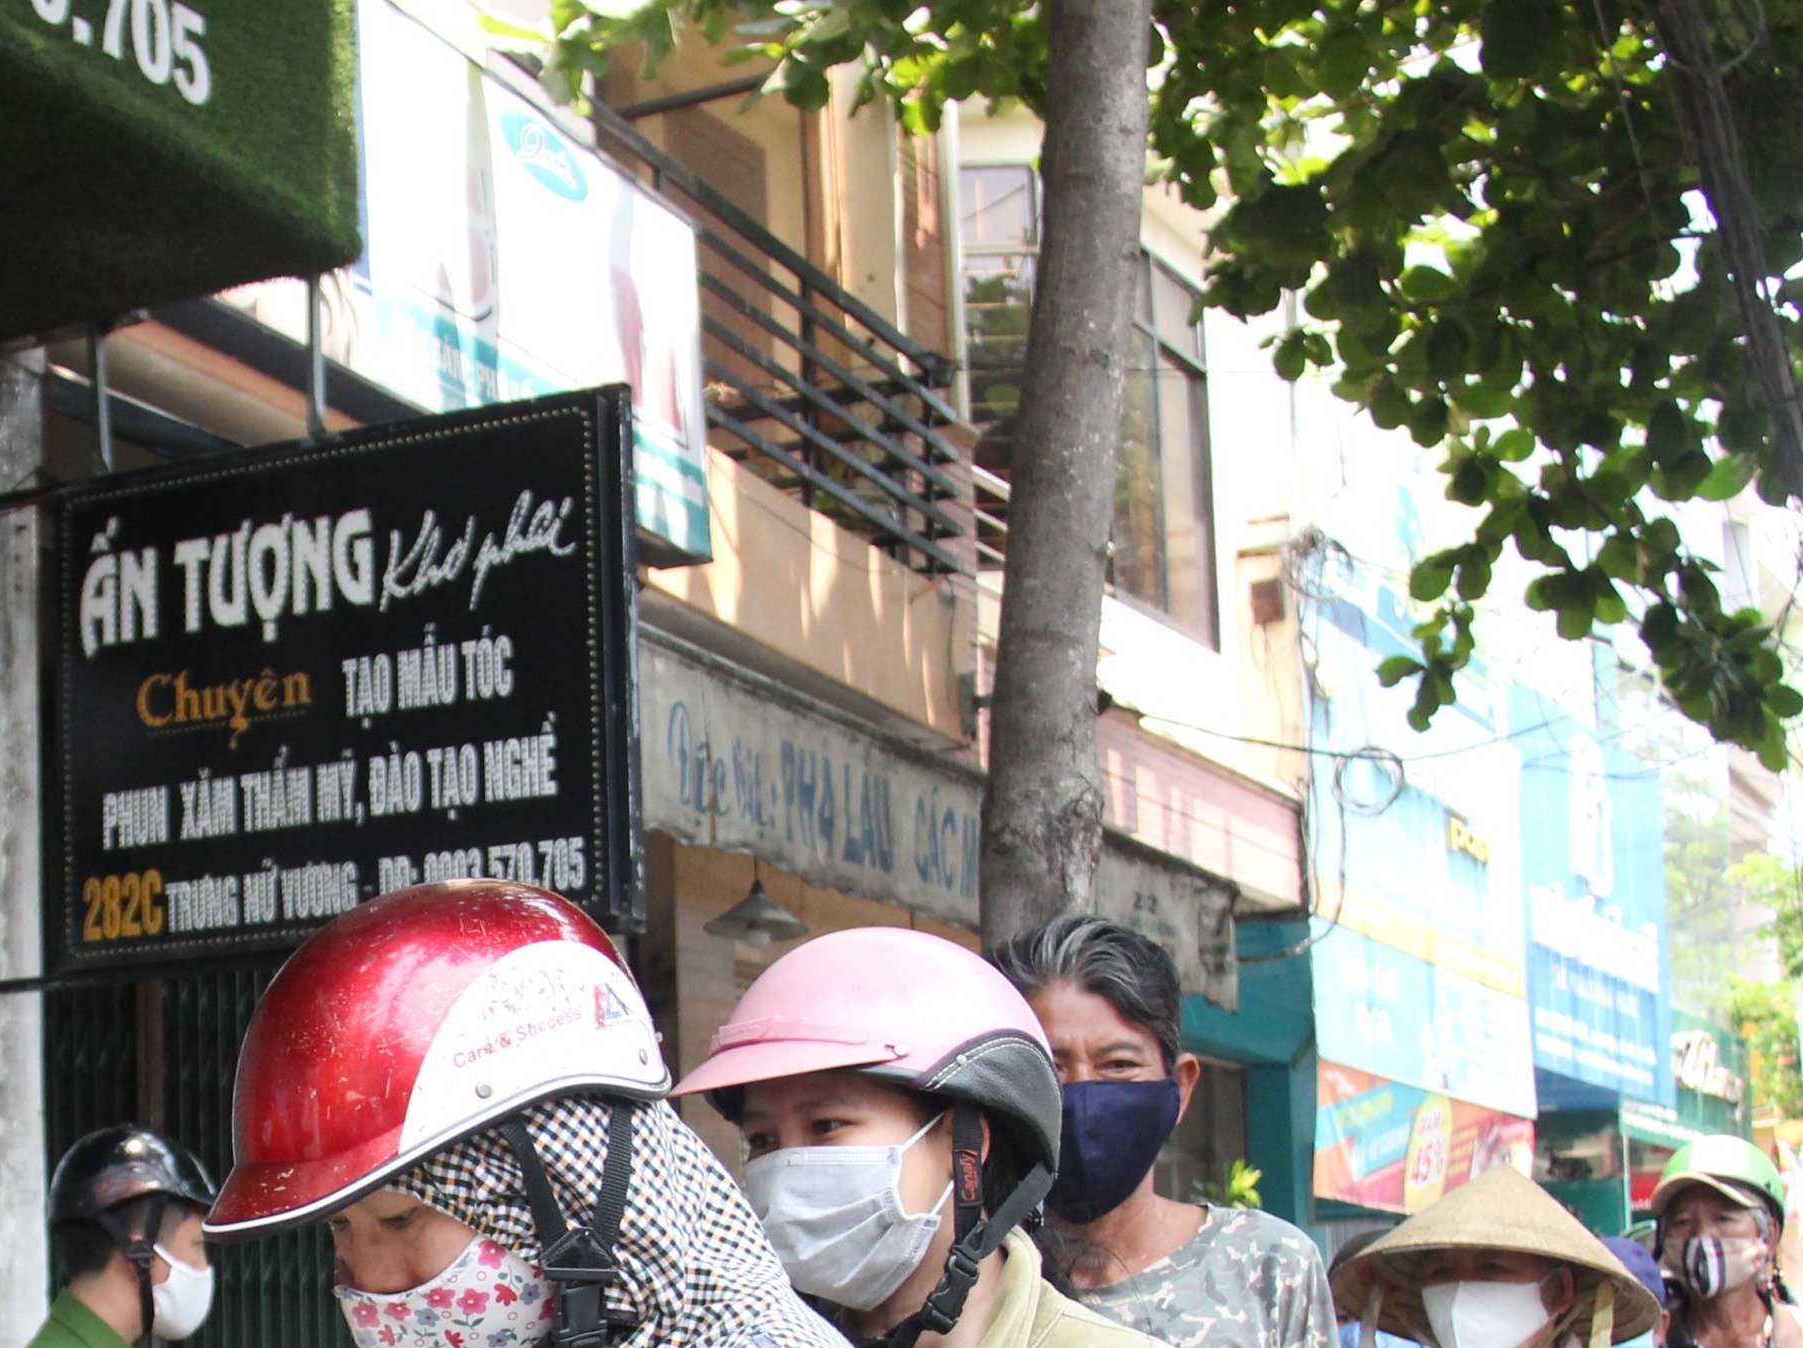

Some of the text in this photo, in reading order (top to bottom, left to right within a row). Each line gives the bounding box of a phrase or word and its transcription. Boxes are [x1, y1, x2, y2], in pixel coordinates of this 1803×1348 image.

[31, 0, 211, 105] .705
[79, 516, 159, 659] ẤN
[173, 507, 374, 643] TƯỢNG
[136, 622, 514, 750] Chuyên TẠO MẪU TÓC
[102, 711, 559, 850] PHUN XĂM THẨM MỸ, ĐÀO TẠO NGHỀ
[82, 868, 166, 942] 282C
[242, 857, 280, 925] NỮ
[280, 860, 360, 921] VƯƠNG
[453, 1042, 495, 1068] Care
[499, 1033, 512, 1048] &
[516, 1008, 583, 1041] Success
